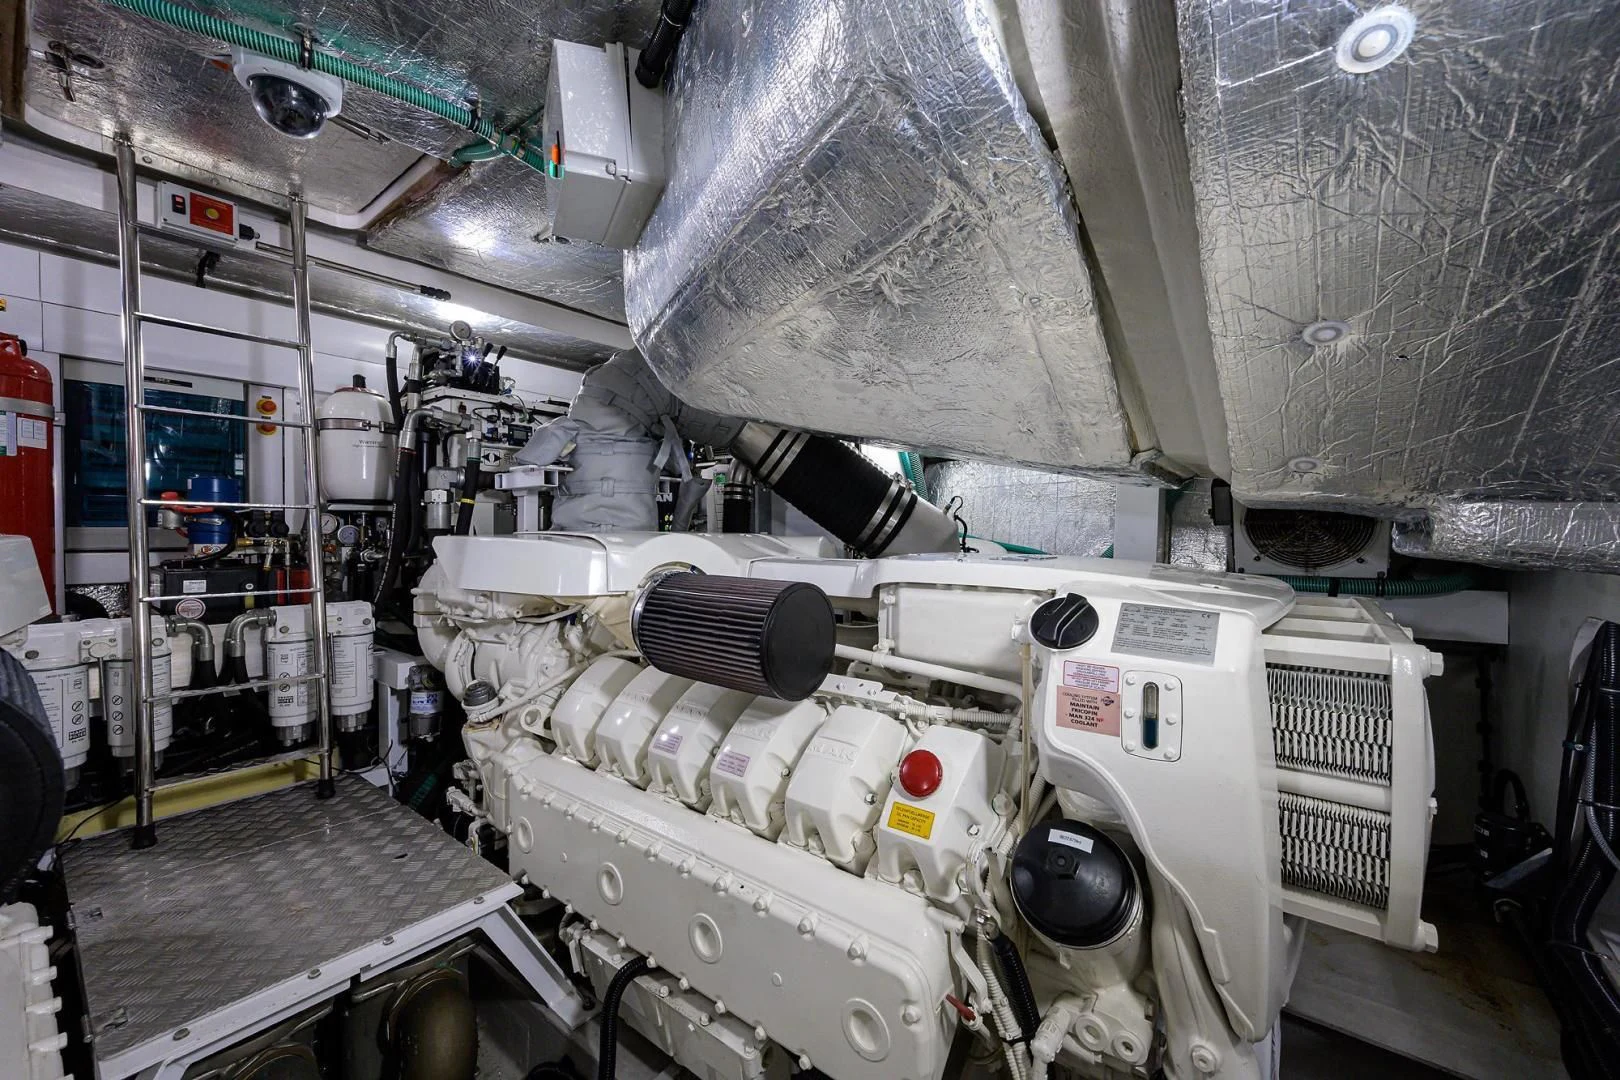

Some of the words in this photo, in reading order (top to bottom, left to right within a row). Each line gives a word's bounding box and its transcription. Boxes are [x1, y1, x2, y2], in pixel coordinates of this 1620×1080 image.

[1069, 702, 1100, 710] MAINTAIN
[1071, 708, 1098, 716] FRICOFIN
[1070, 719, 1098, 727] COOLANT
